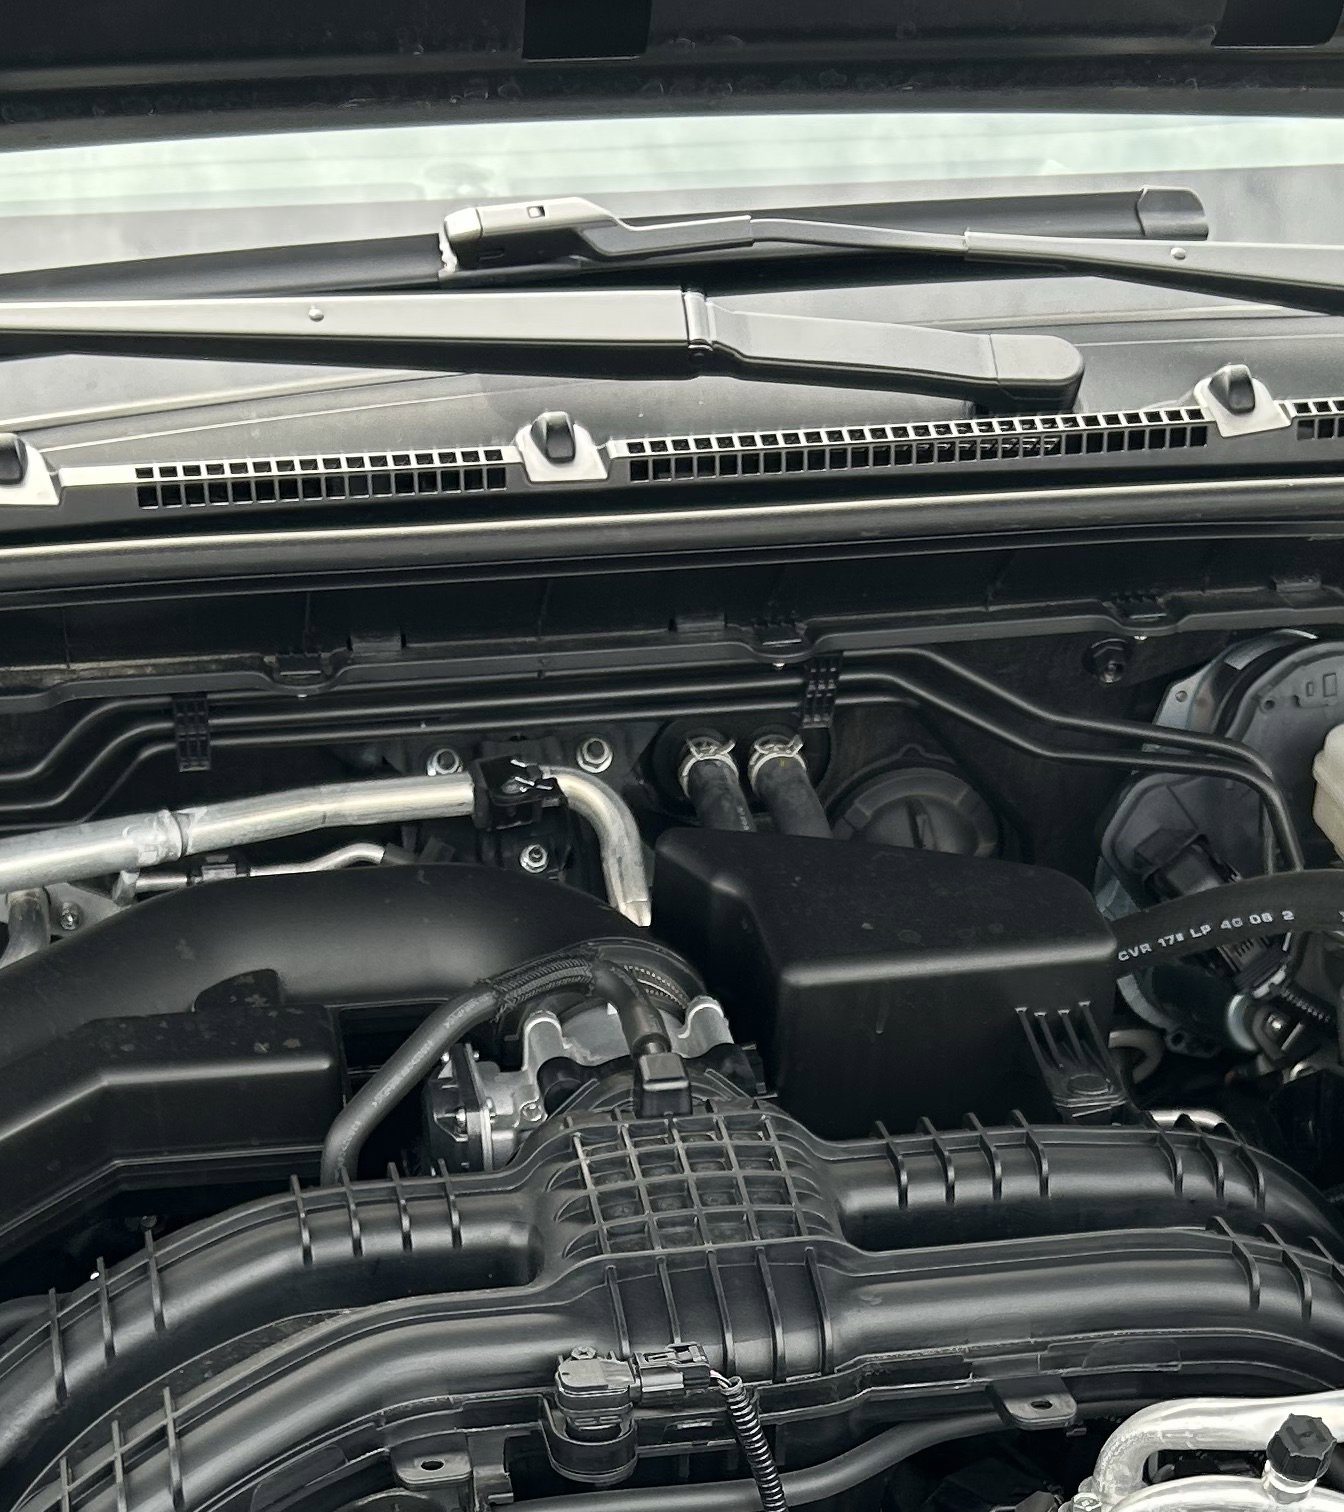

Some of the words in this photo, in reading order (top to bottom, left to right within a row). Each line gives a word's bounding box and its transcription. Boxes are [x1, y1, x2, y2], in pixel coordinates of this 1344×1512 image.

[1117, 942, 1153, 962] CVR
[1189, 923, 1212, 939] LP
[1281, 909, 1295, 922] 2
